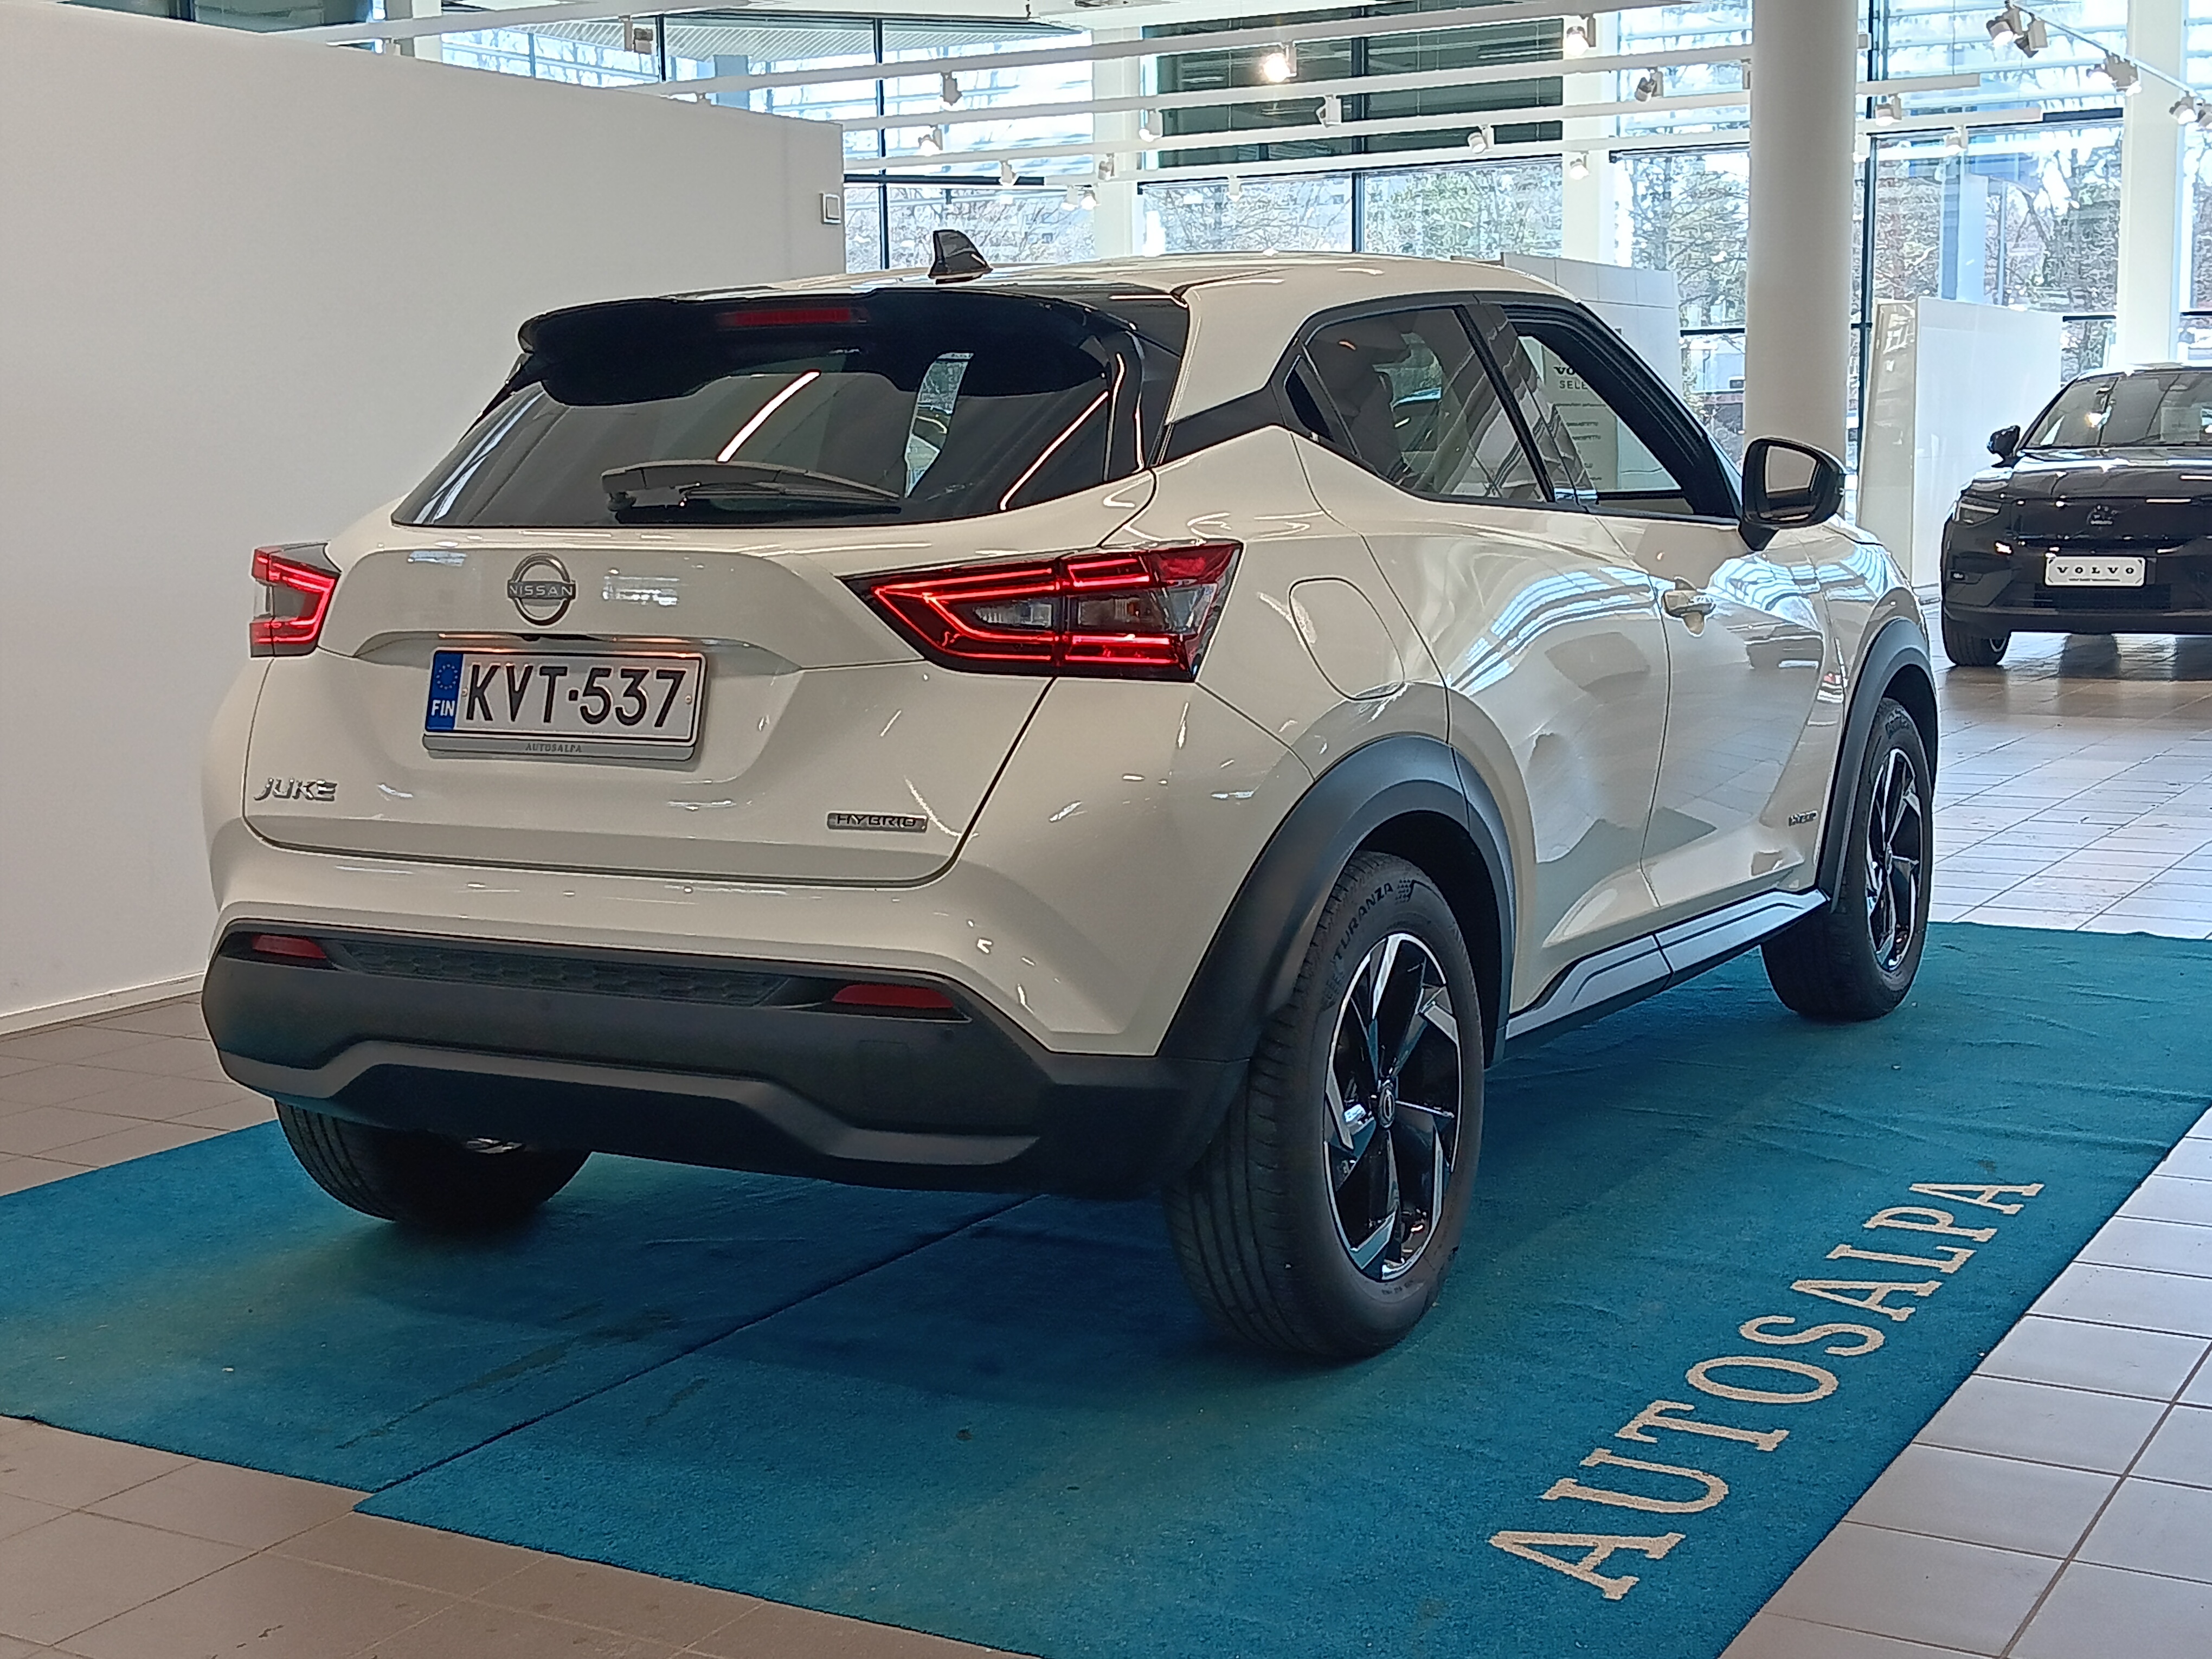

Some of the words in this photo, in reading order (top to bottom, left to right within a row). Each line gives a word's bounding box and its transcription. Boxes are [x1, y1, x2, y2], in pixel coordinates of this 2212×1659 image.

[510, 585, 573, 596] NISSAN
[431, 699, 455, 717] FIN
[525, 743, 582, 753] AUTOSALPA
[253, 777, 338, 802] JUKE
[837, 814, 916, 827] HYBRID
[1333, 882, 1394, 961] TURANZA
[1488, 1182, 2045, 1601] AUTOSALPA
